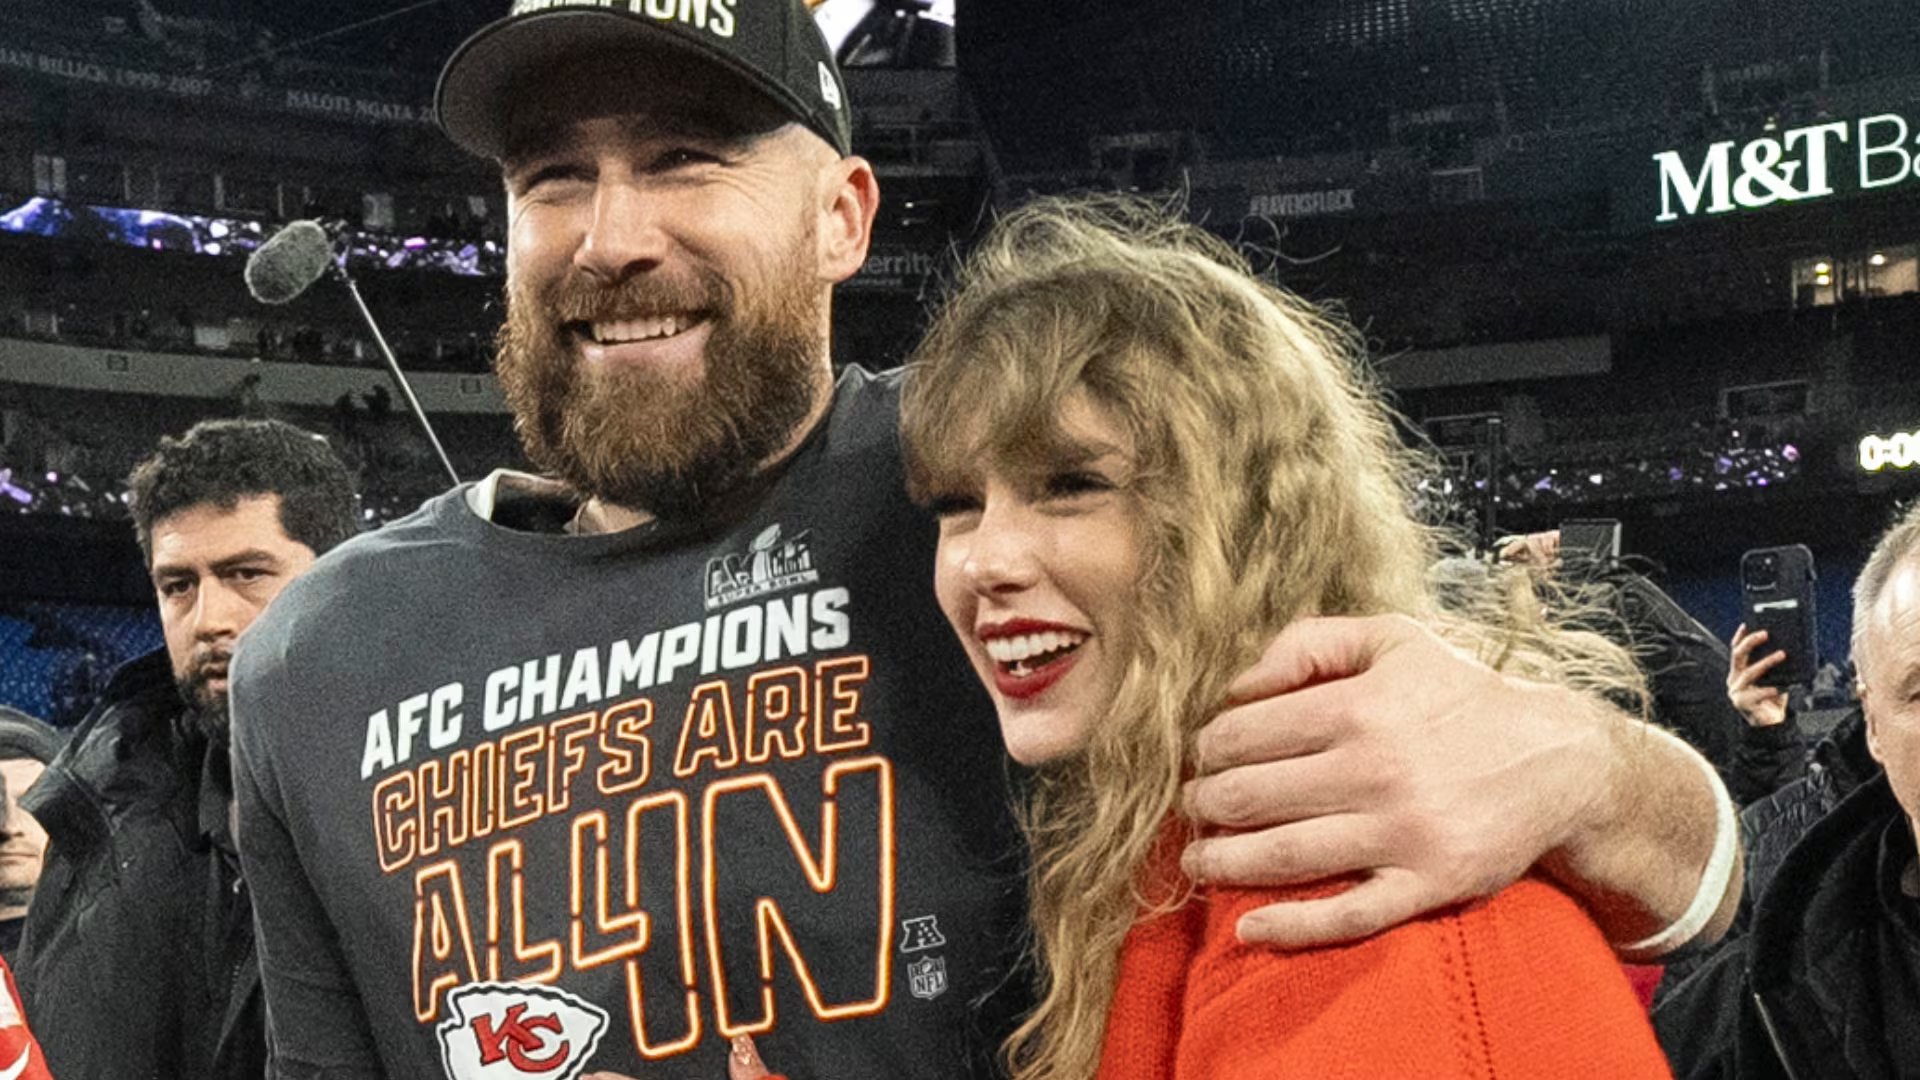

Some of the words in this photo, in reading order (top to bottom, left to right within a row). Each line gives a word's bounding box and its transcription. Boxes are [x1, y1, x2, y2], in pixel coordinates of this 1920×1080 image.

[1652, 121, 1847, 221] M&T
[1858, 113, 1920, 188] B
[864, 252, 931, 276] erritt
[361, 681, 464, 780] AFC
[483, 586, 851, 732] CHAMPIONS
[373, 698, 654, 873] CHIEFS
[673, 654, 870, 778] ARE
[413, 811, 649, 1022] ALL
[625, 756, 894, 1060] IN
[913, 970, 945, 995] NFL
[470, 1001, 571, 1073] KC
